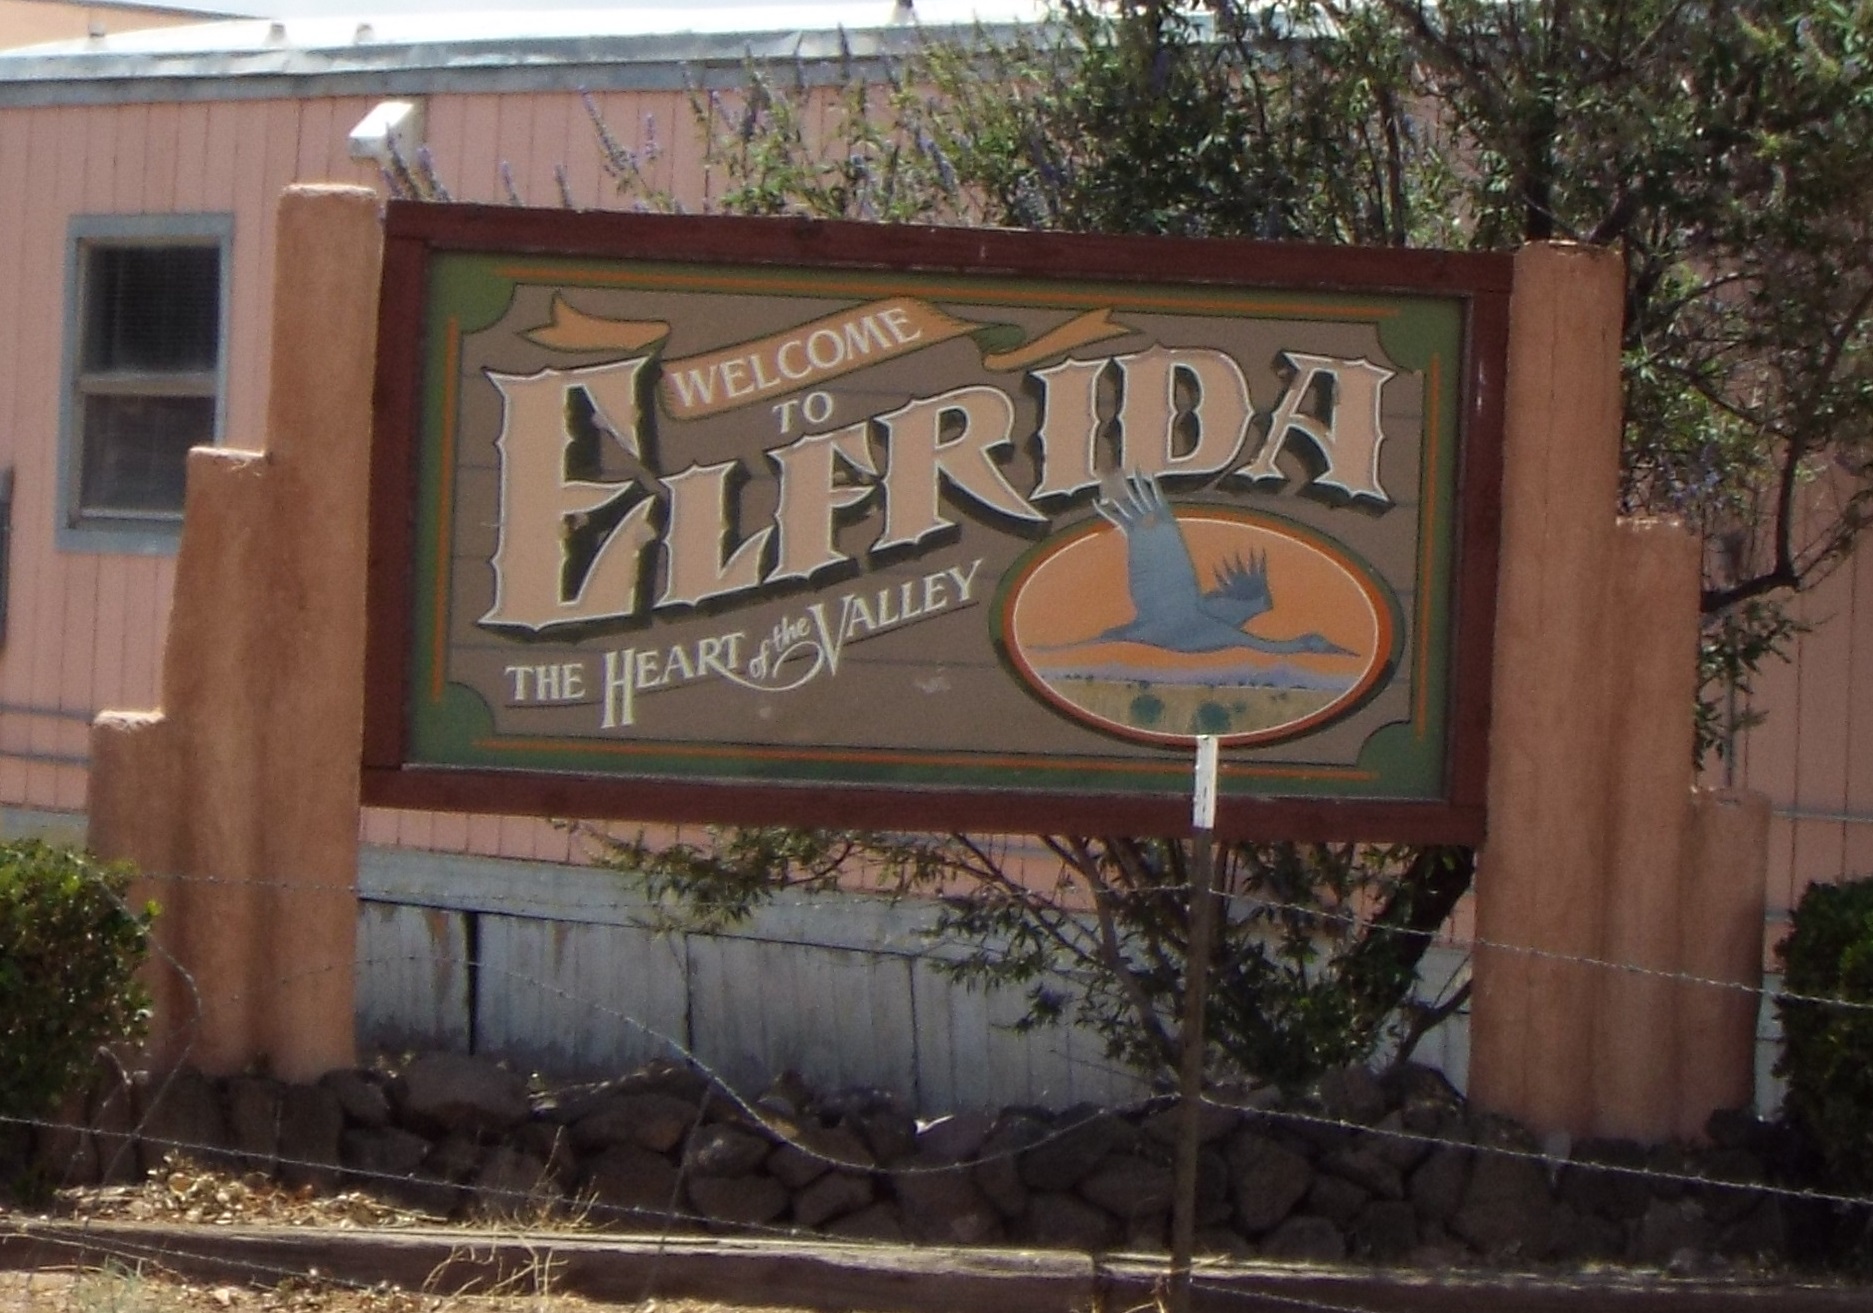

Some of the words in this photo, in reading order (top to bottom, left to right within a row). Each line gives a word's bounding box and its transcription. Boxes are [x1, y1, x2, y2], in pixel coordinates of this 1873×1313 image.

[669, 307, 922, 407] WELCOME
[772, 391, 834, 434] TO
[477, 343, 1398, 632] ELFRIDA
[505, 663, 586, 700] THE
[600, 632, 745, 729] HEART
[748, 642, 770, 680] of
[772, 614, 810, 650] the
[808, 558, 983, 676] VALLEY
